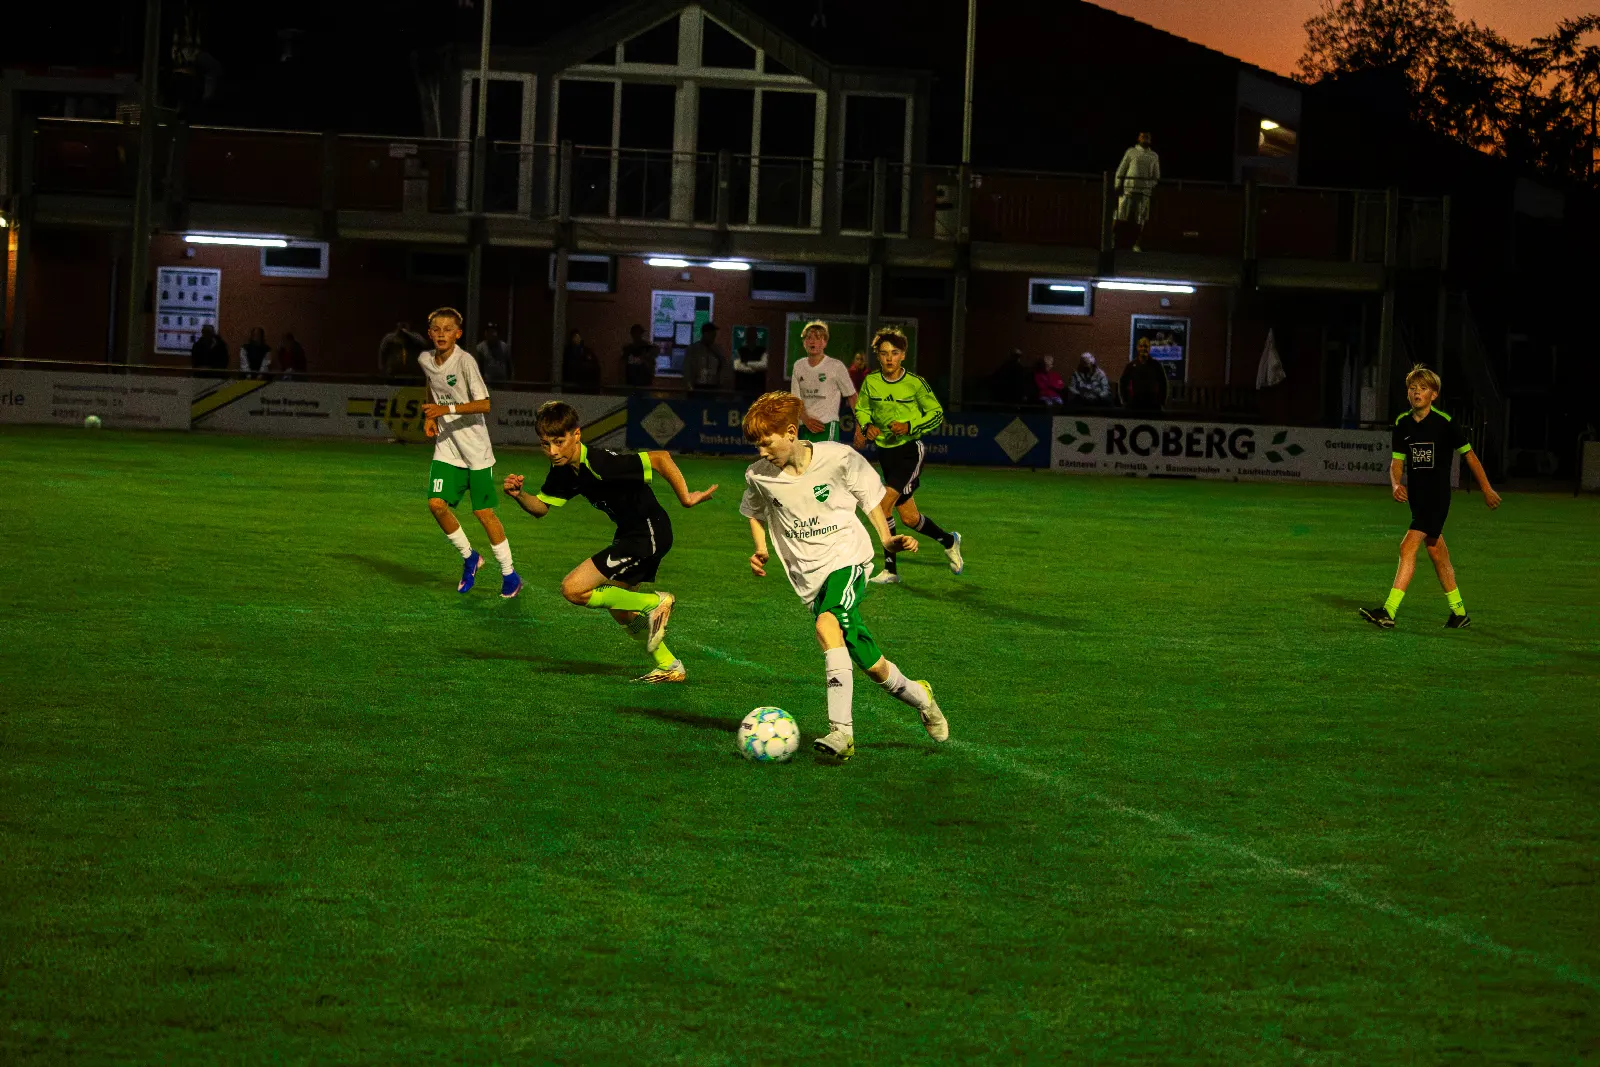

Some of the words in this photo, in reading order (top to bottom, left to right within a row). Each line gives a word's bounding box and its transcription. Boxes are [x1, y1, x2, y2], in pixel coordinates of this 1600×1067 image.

[373, 398, 425, 419] ELS
[1106, 424, 1255, 460] ROBERG
[1376, 442, 1383, 451] 3
[1347, 461, 1383, 472] 04442
[432, 478, 444, 493] 10
[793, 515, 820, 529] S.u.W.
